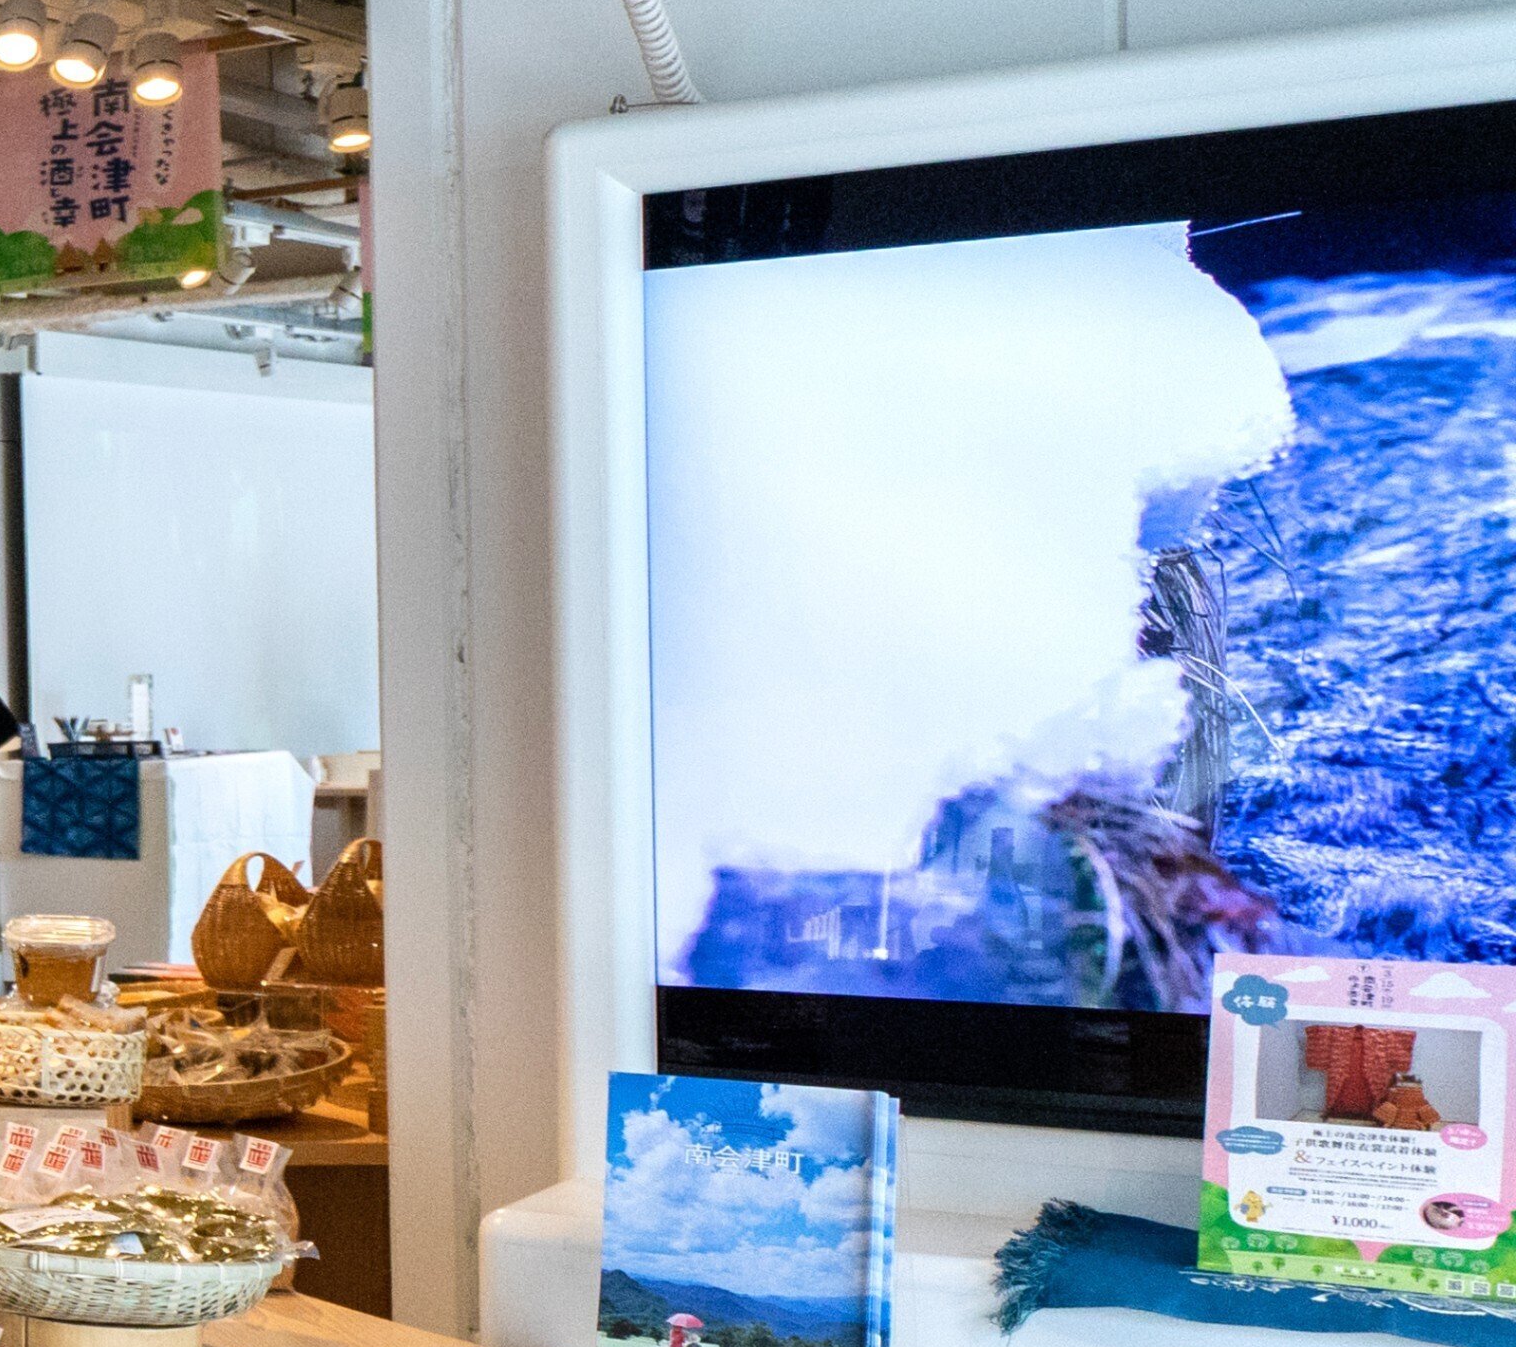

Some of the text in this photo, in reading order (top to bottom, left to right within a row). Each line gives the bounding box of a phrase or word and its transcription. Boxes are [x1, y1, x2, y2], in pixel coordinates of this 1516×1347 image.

[85, 77, 134, 223] 南会津町
[684, 1143, 805, 1176] 南会津町
